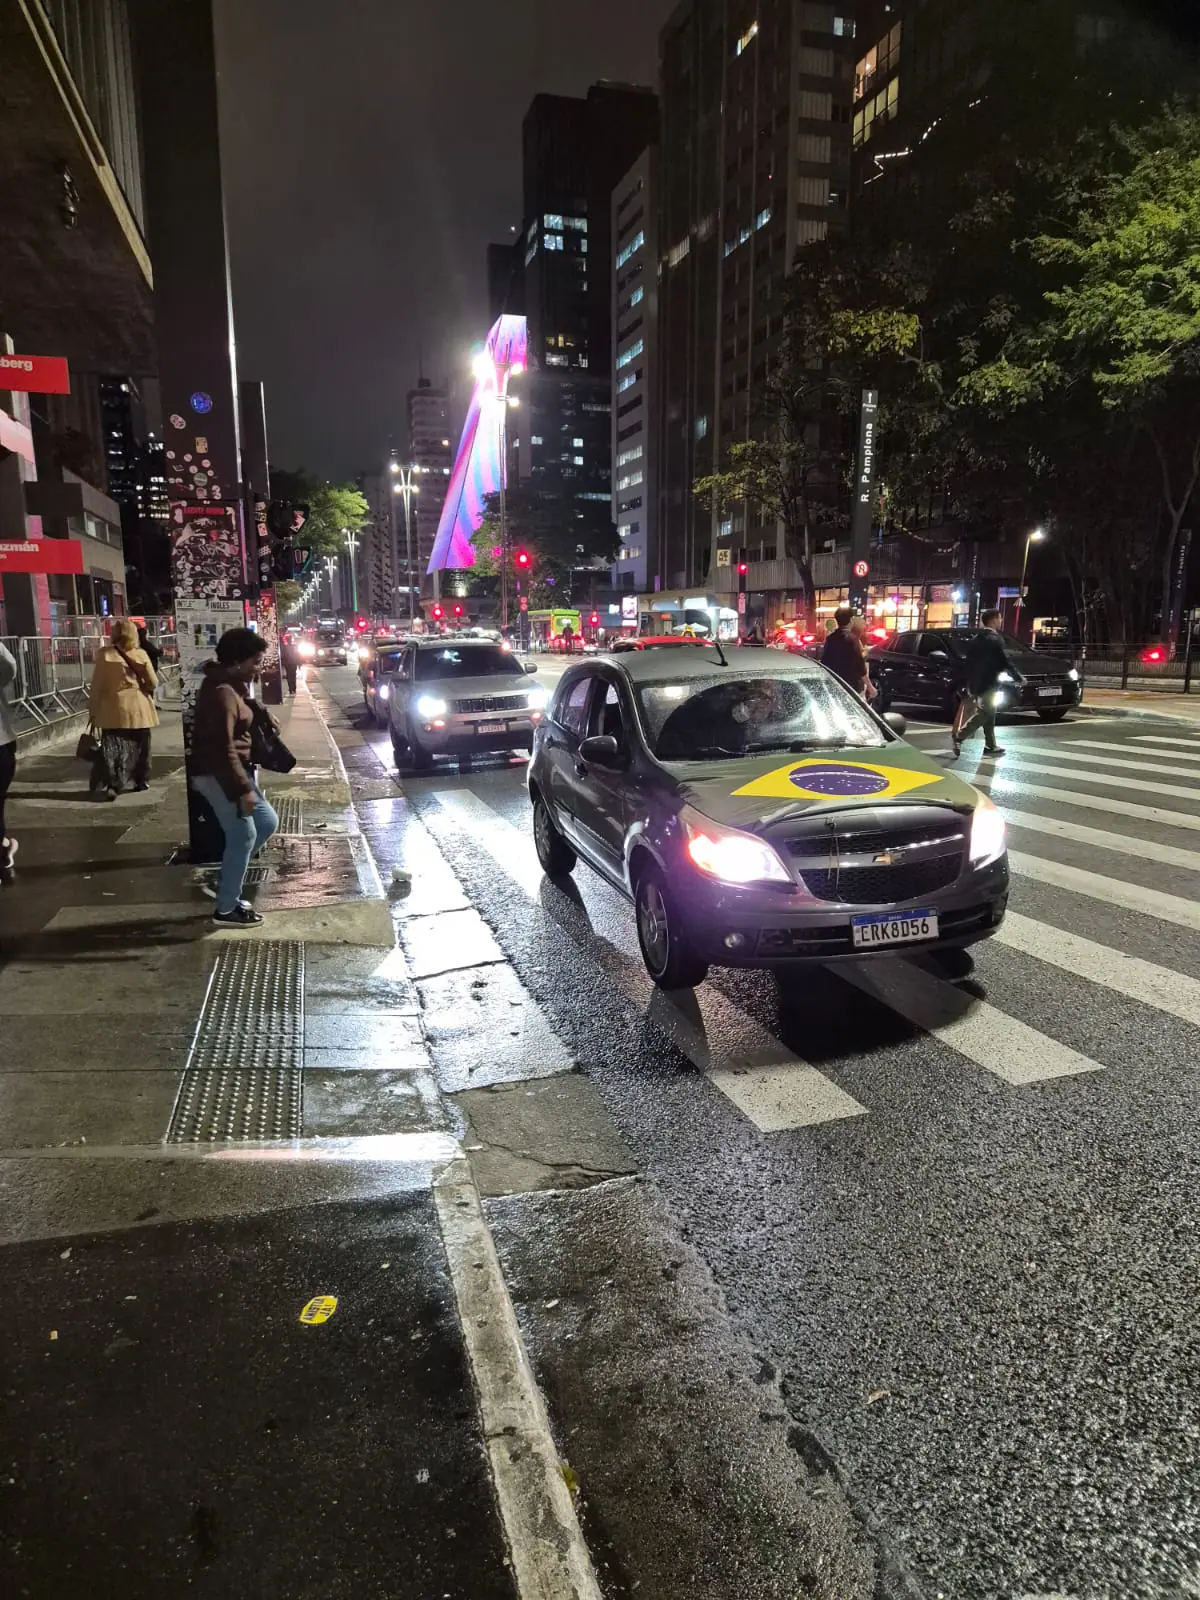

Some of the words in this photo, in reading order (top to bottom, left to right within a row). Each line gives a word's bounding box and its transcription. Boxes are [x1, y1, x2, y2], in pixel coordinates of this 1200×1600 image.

[0, 357, 33, 371] berg
[861, 423, 873, 483] Pamplona
[861, 489, 870, 502] R.
[861, 918, 930, 942] ERK8D56
